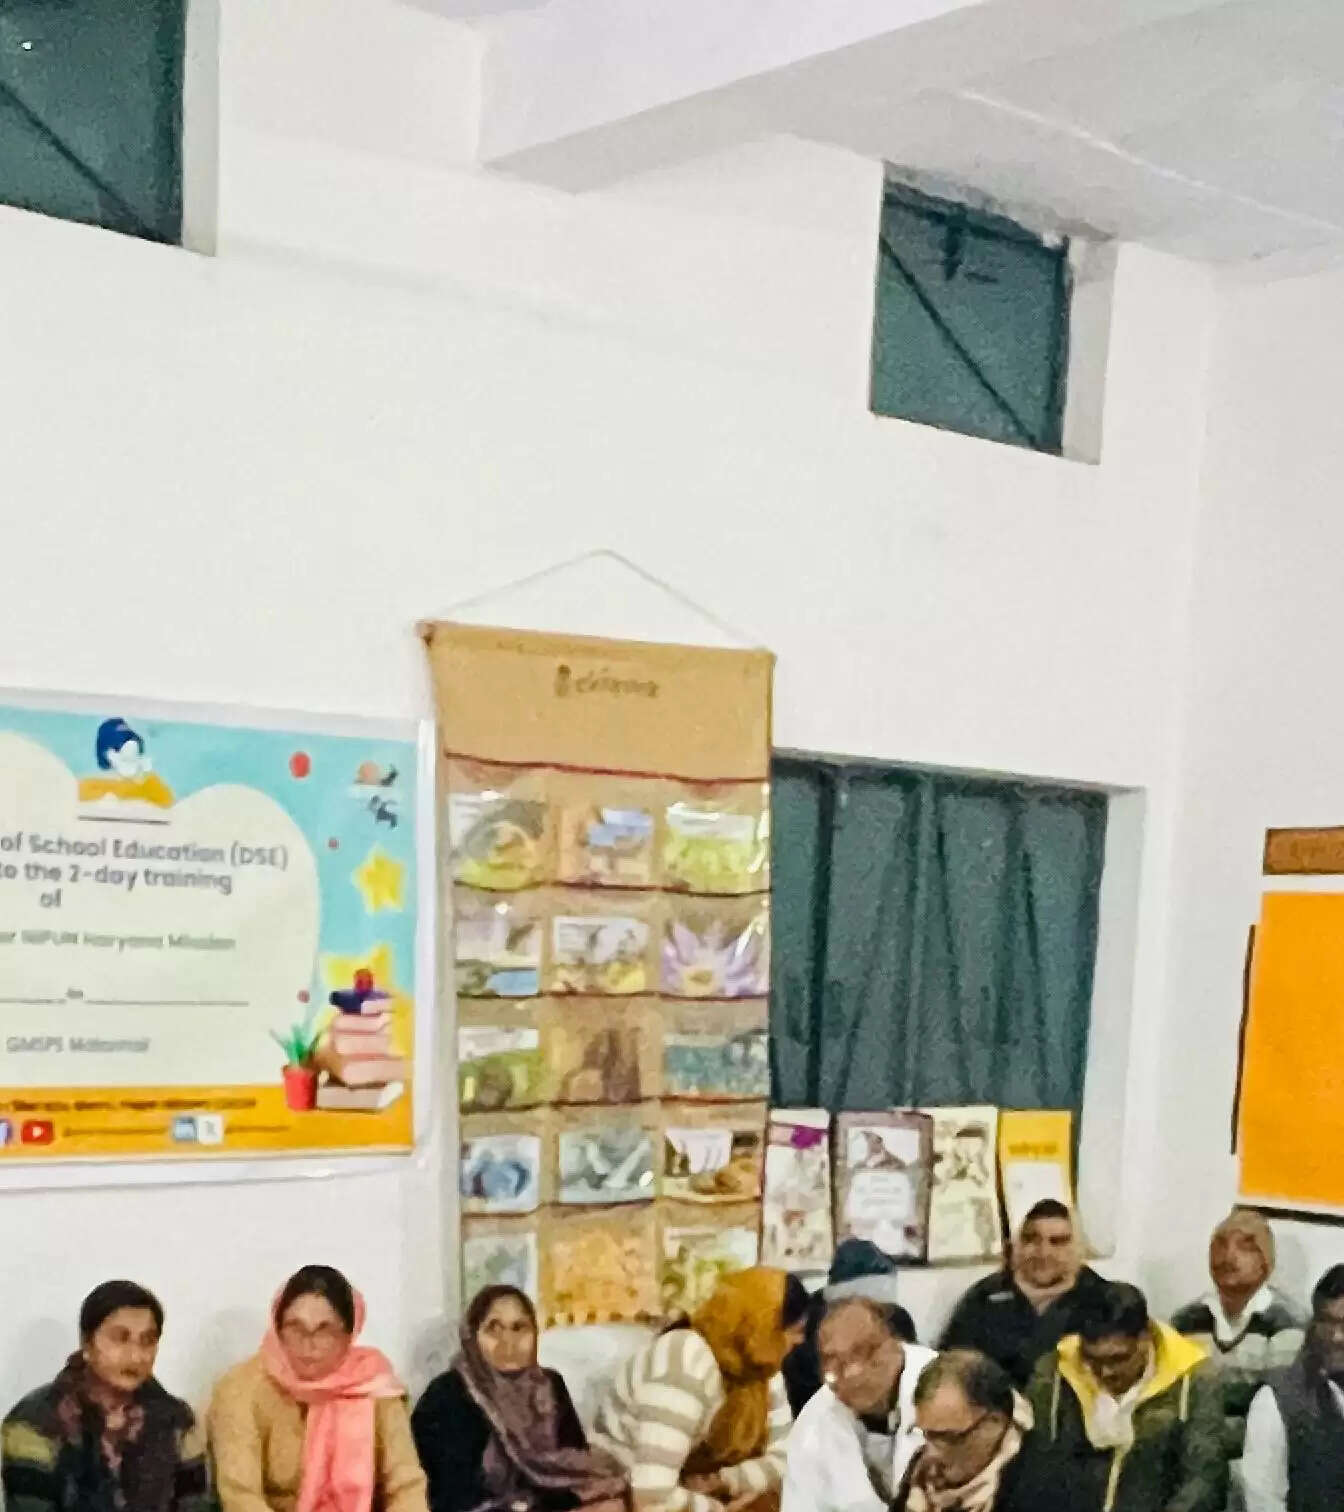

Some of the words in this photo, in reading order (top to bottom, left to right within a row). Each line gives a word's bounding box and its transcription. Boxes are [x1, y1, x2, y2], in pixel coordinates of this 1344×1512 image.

[0, 831, 23, 851] of
[28, 833, 106, 857] School
[112, 838, 224, 864] Education
[230, 840, 288, 871] (DSE)
[24, 862, 62, 883] the
[69, 864, 138, 891] 2-day
[144, 868, 233, 895] training
[40, 889, 62, 908] of
